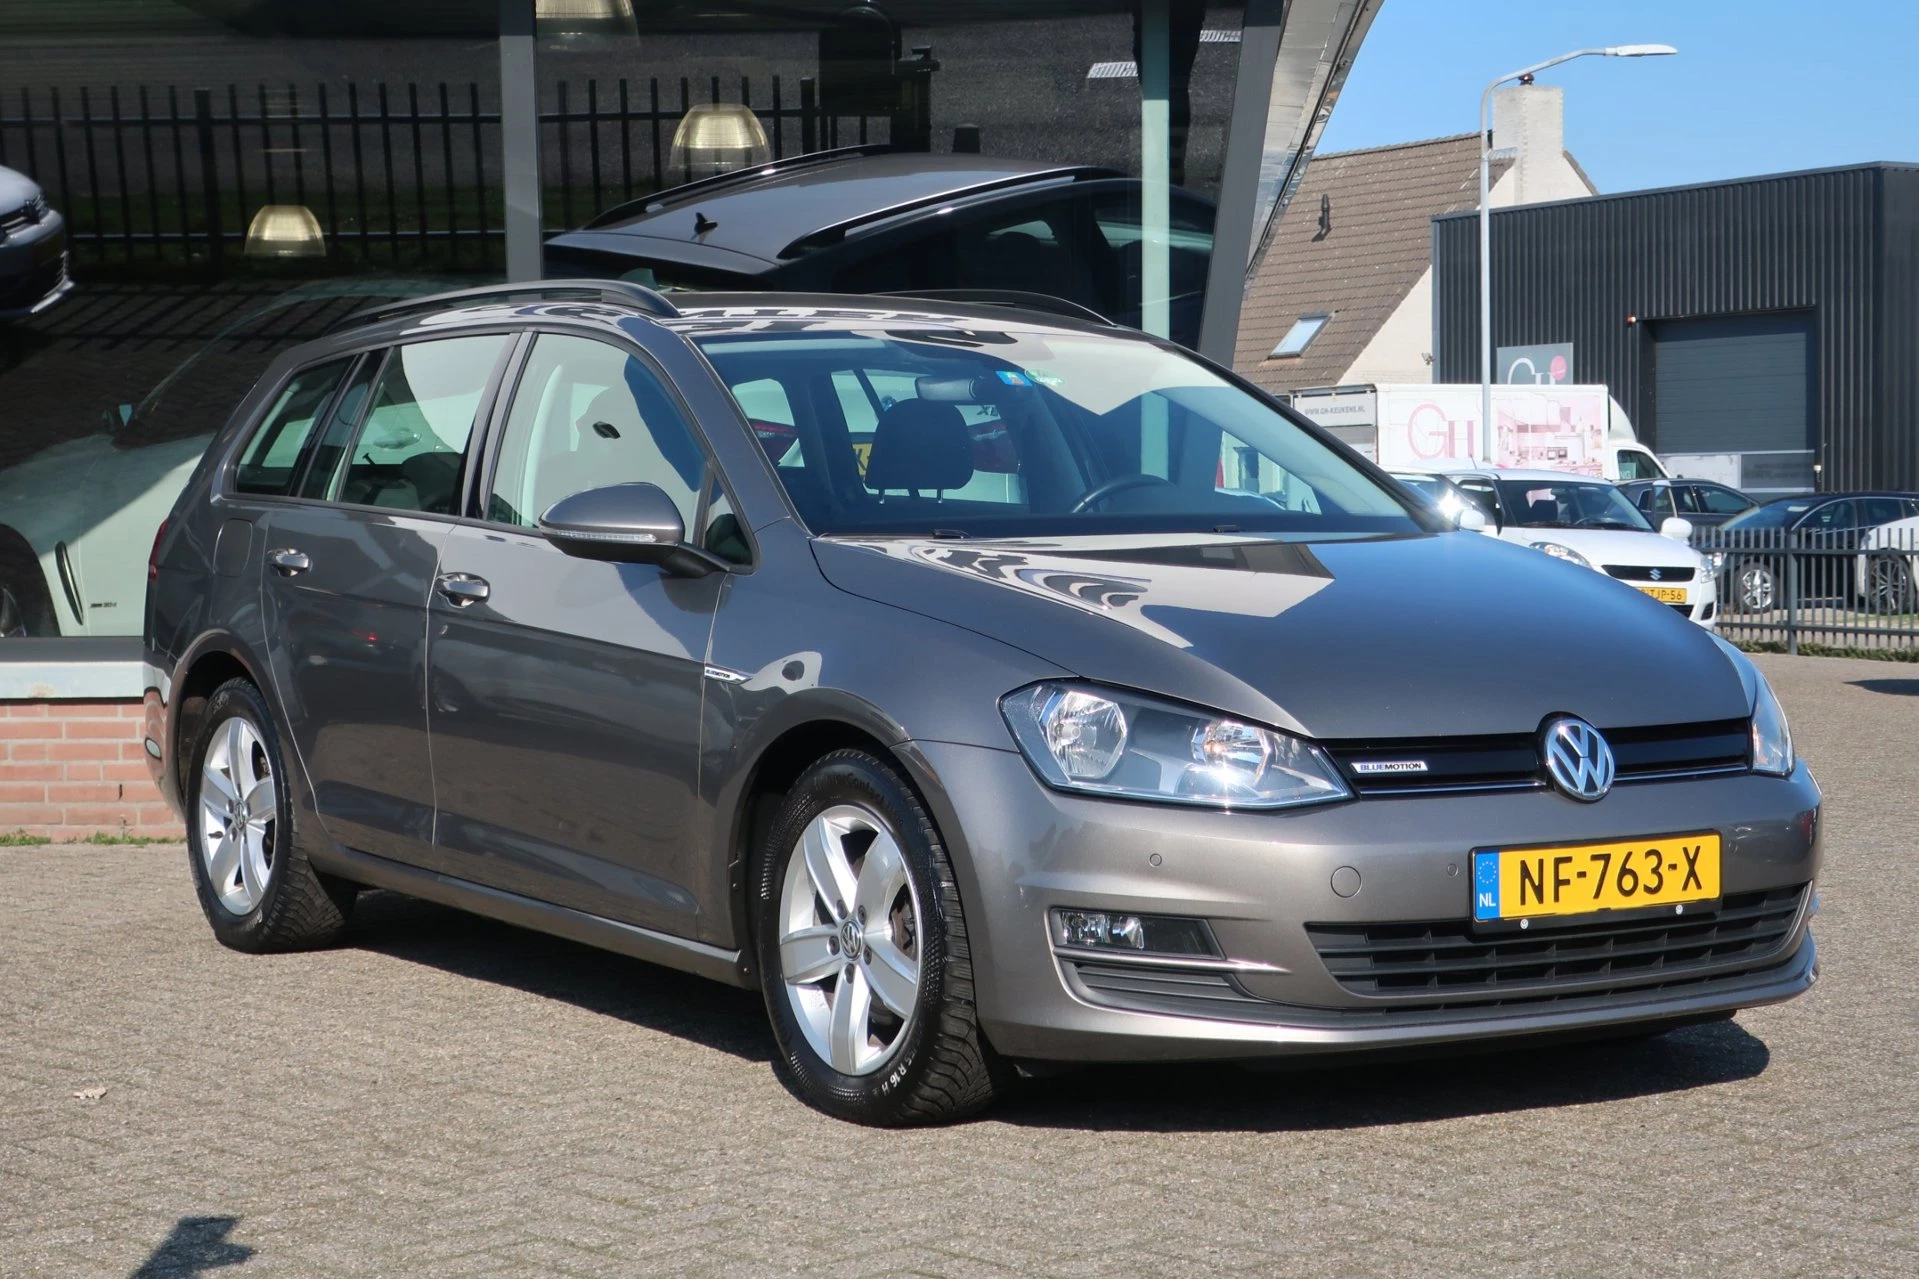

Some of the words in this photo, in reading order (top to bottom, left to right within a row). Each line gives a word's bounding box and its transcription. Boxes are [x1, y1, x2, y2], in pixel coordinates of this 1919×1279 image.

[1360, 762, 1421, 771] BLUEMOTION
[1519, 845, 1702, 906] NF-763-X
[1479, 892, 1496, 907] NL
